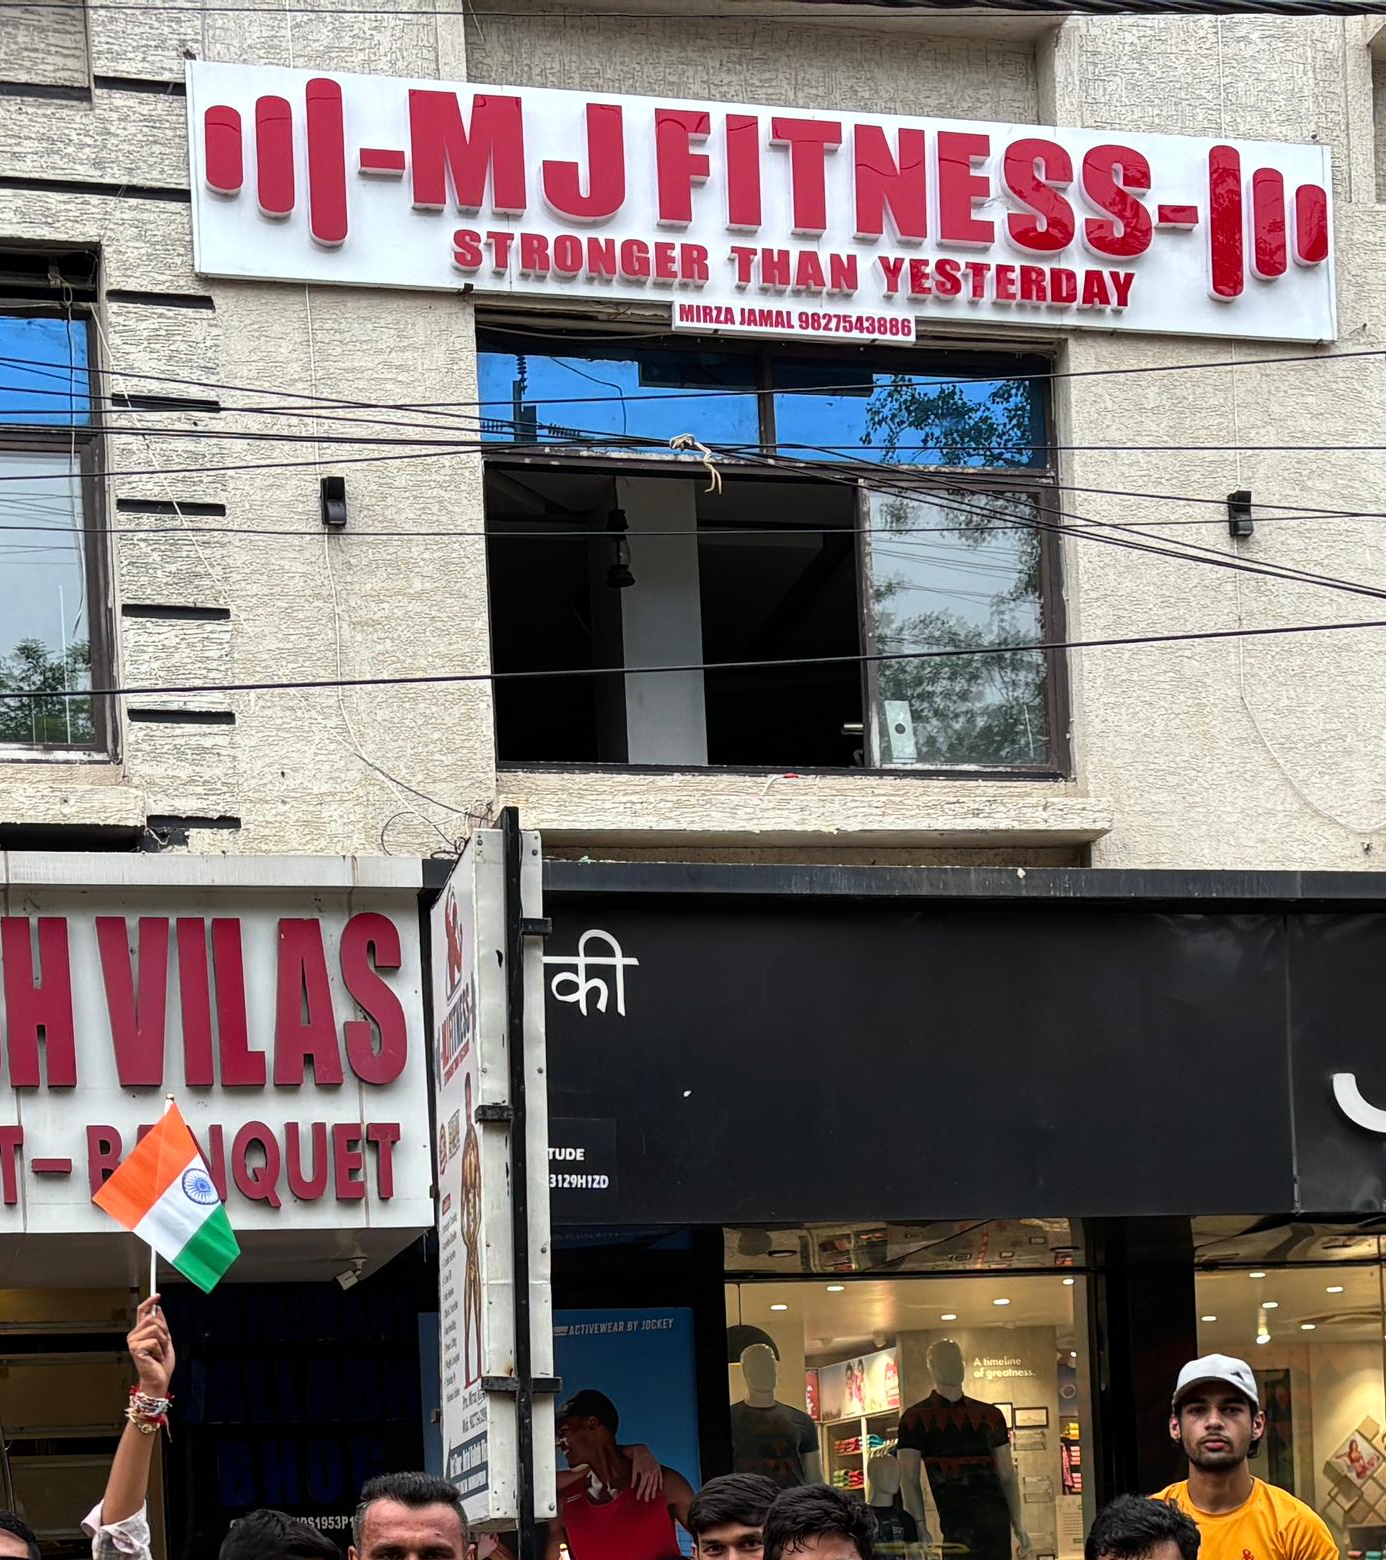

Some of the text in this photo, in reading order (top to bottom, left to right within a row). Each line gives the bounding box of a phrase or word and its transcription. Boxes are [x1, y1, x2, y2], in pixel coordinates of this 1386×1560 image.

[453, 228, 1136, 310] STRONGER THAN YESTERDAY
[679, 304, 912, 336] MIRZA JAMAL 9827543886
[96, 912, 407, 1088] VILAS
[548, 1148, 585, 1161] TUDE
[568, 1318, 674, 1335] ACTIVEWEAR BY JOCKEY
[973, 1355, 1022, 1367] A timeline
